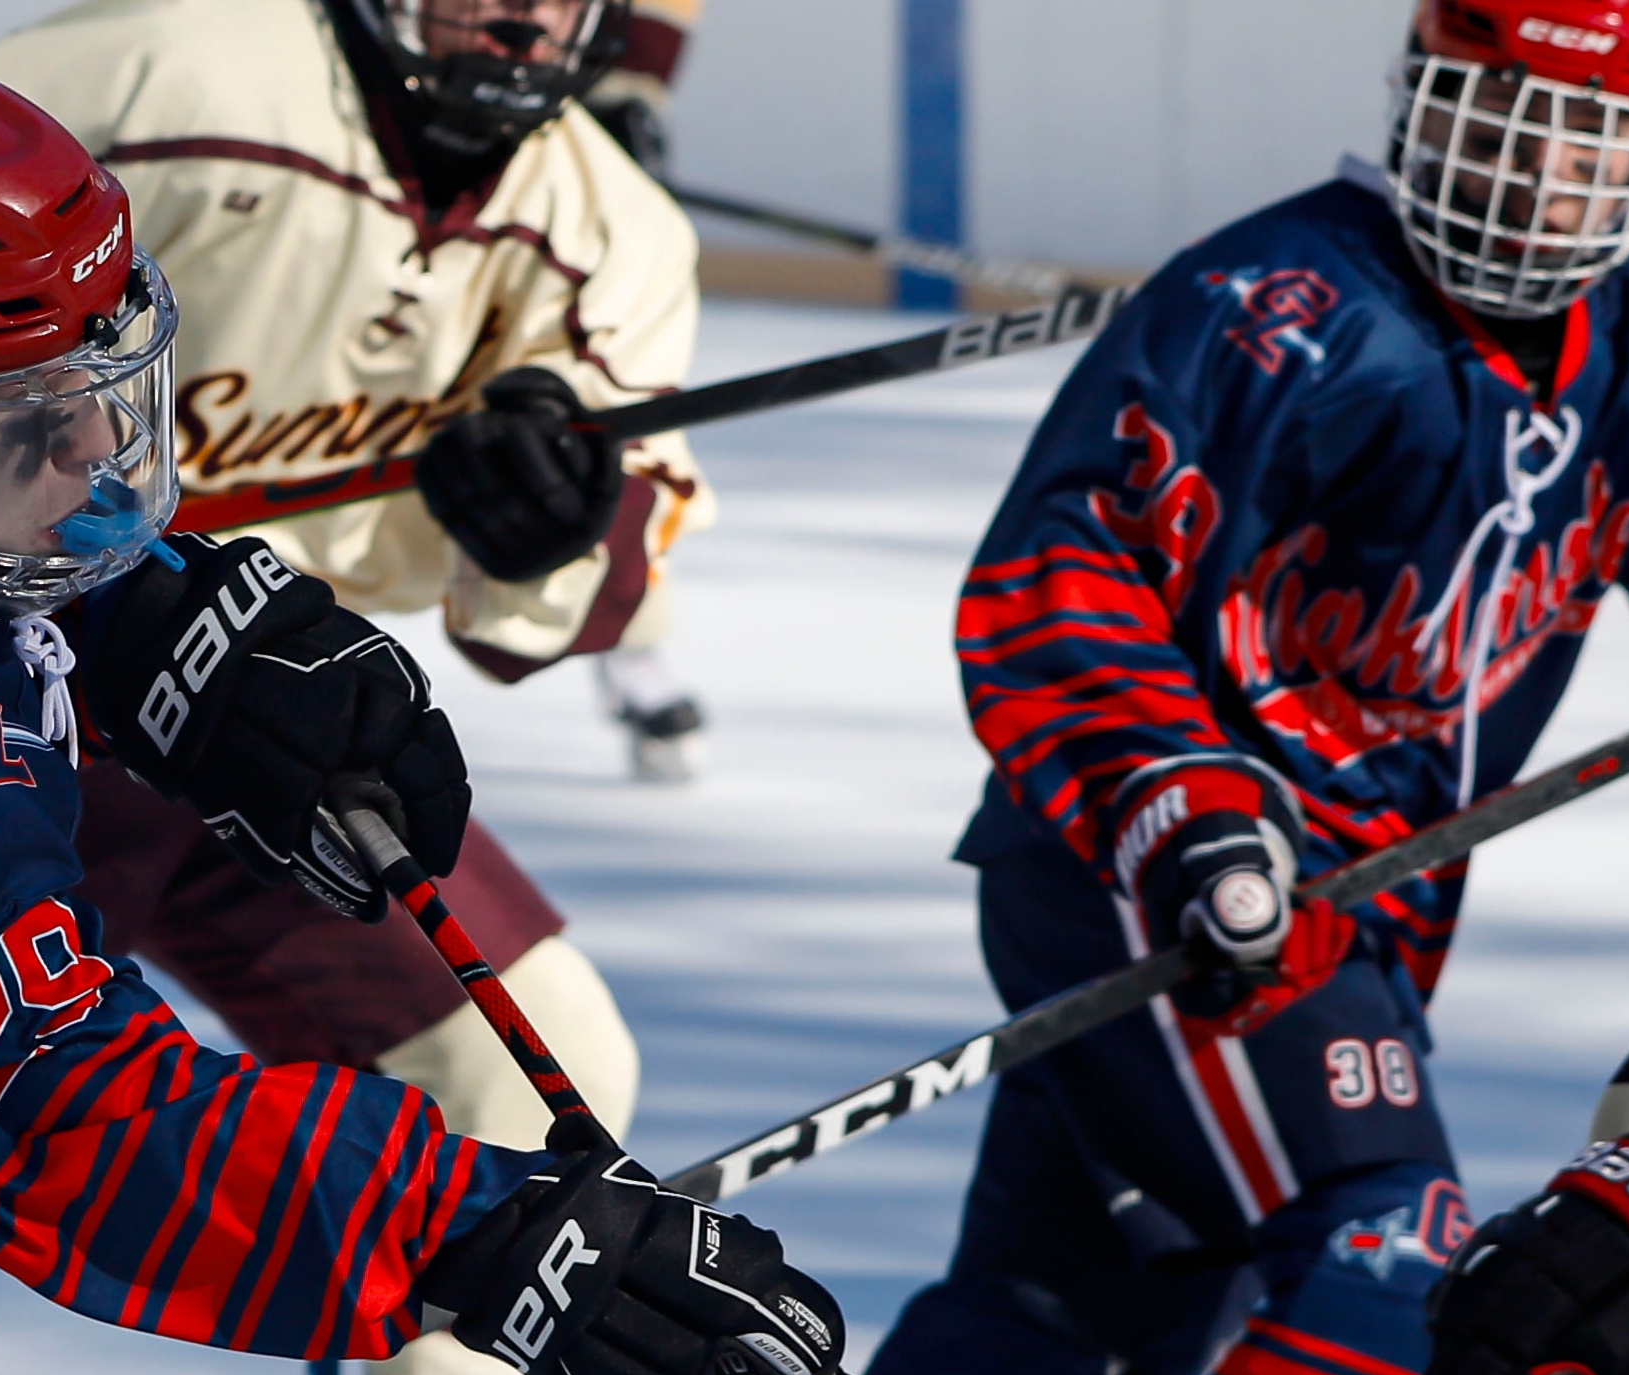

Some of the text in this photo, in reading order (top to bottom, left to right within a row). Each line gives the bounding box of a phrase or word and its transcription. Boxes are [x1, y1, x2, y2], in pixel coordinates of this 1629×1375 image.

[1518, 16, 1619, 56] CCM
[937, 283, 1140, 370] BAU
[1324, 1037, 1418, 1111] 38
[716, 1035, 995, 1199] CCM
[704, 1215, 721, 1269] NSX
[753, 1338, 803, 1374] BAUER
